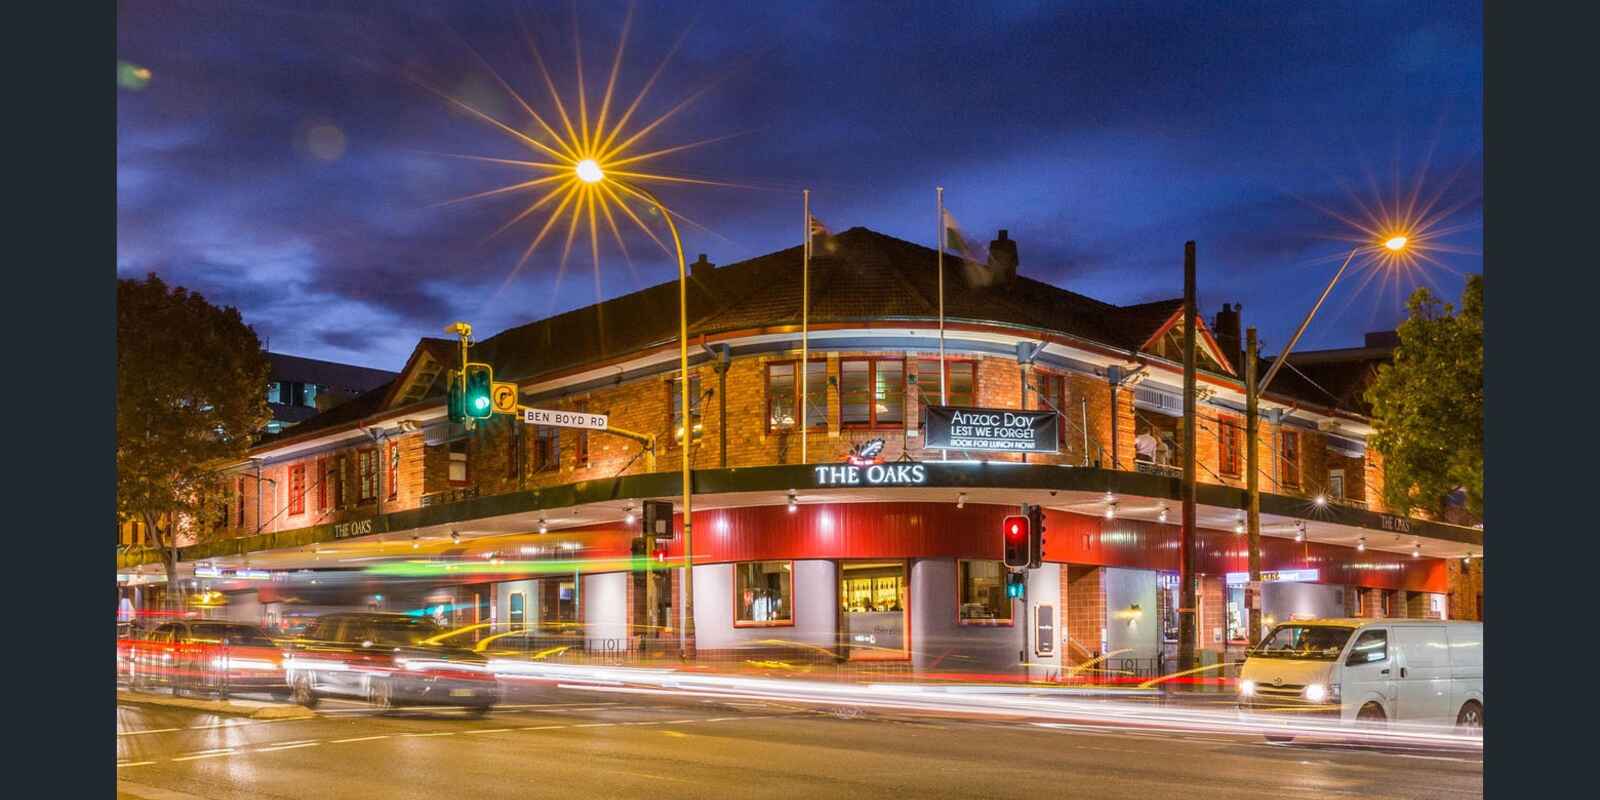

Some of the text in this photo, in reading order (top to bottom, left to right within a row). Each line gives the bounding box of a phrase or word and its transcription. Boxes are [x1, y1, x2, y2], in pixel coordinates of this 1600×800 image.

[527, 411, 604, 426] BEN BOYD RD
[951, 410, 1034, 429] Anzac Day
[951, 426, 1034, 438] LEST WE FORGET
[973, 440, 988, 448] FOR
[989, 440, 1014, 449] LUNCH
[815, 465, 925, 484] THE OAKS
[335, 520, 372, 538] THE OAKS
